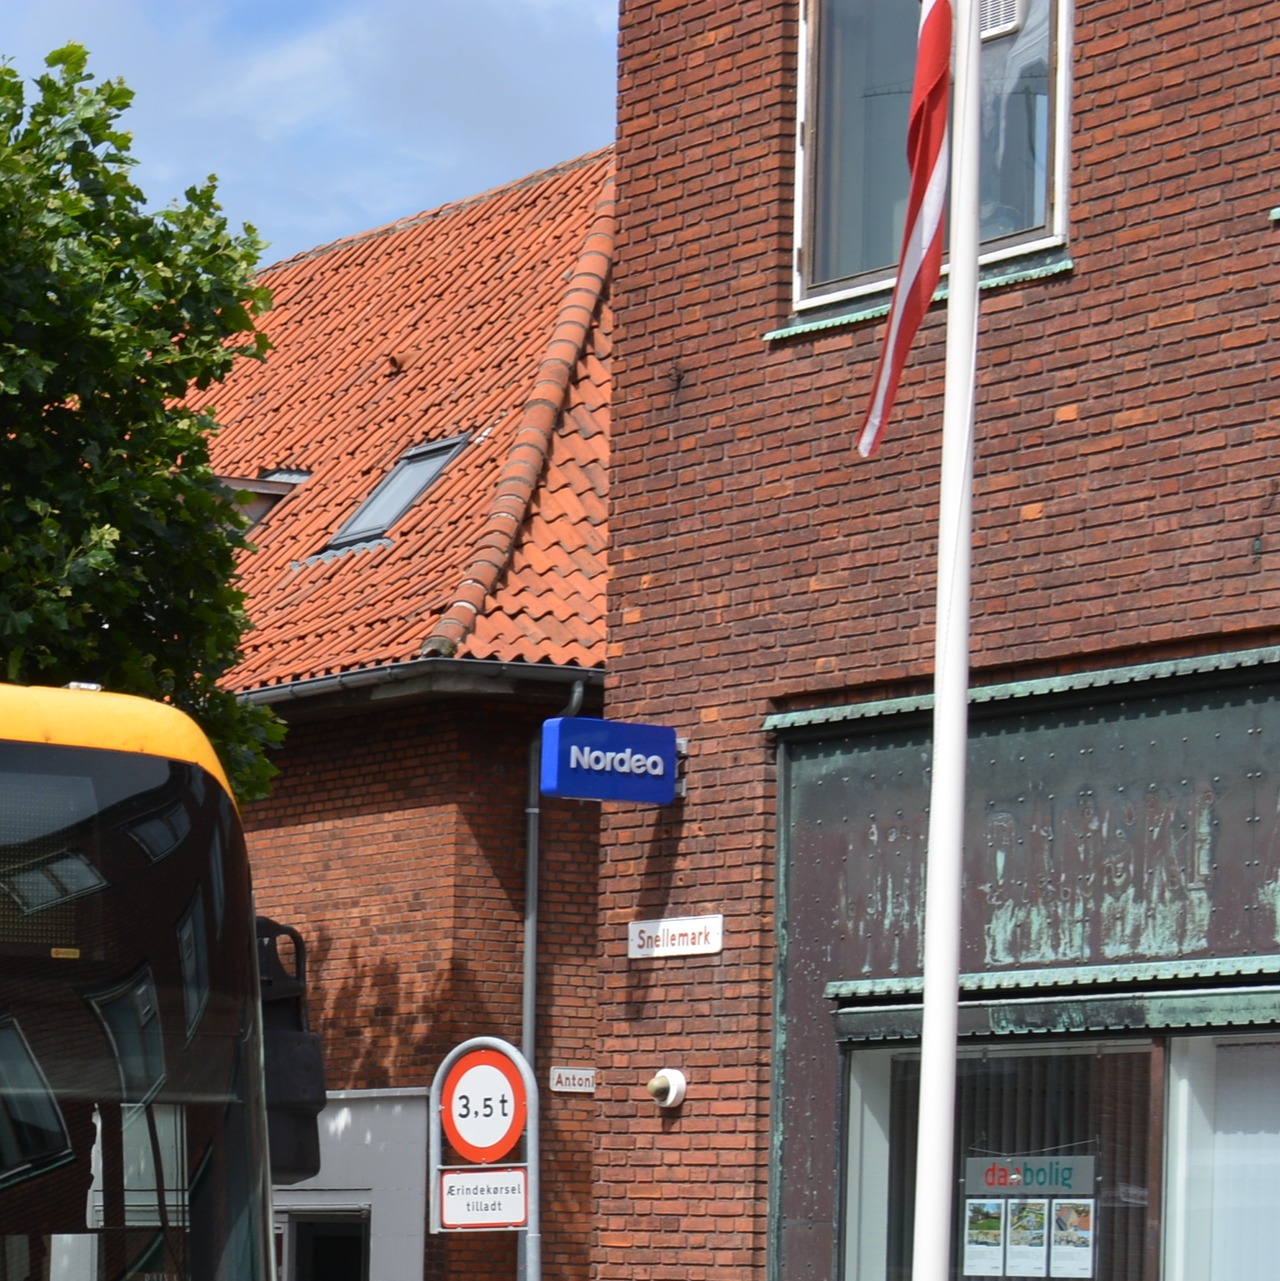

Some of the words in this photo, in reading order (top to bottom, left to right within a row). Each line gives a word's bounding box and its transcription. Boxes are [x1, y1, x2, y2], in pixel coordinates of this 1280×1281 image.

[569, 745, 664, 776] Nordea
[636, 925, 711, 950] Snellemark
[458, 1095, 493, 1119] 3,5
[500, 1093, 509, 1117] t
[447, 1185, 521, 1196] Ærindekørsel
[466, 1202, 502, 1212] tilladt
